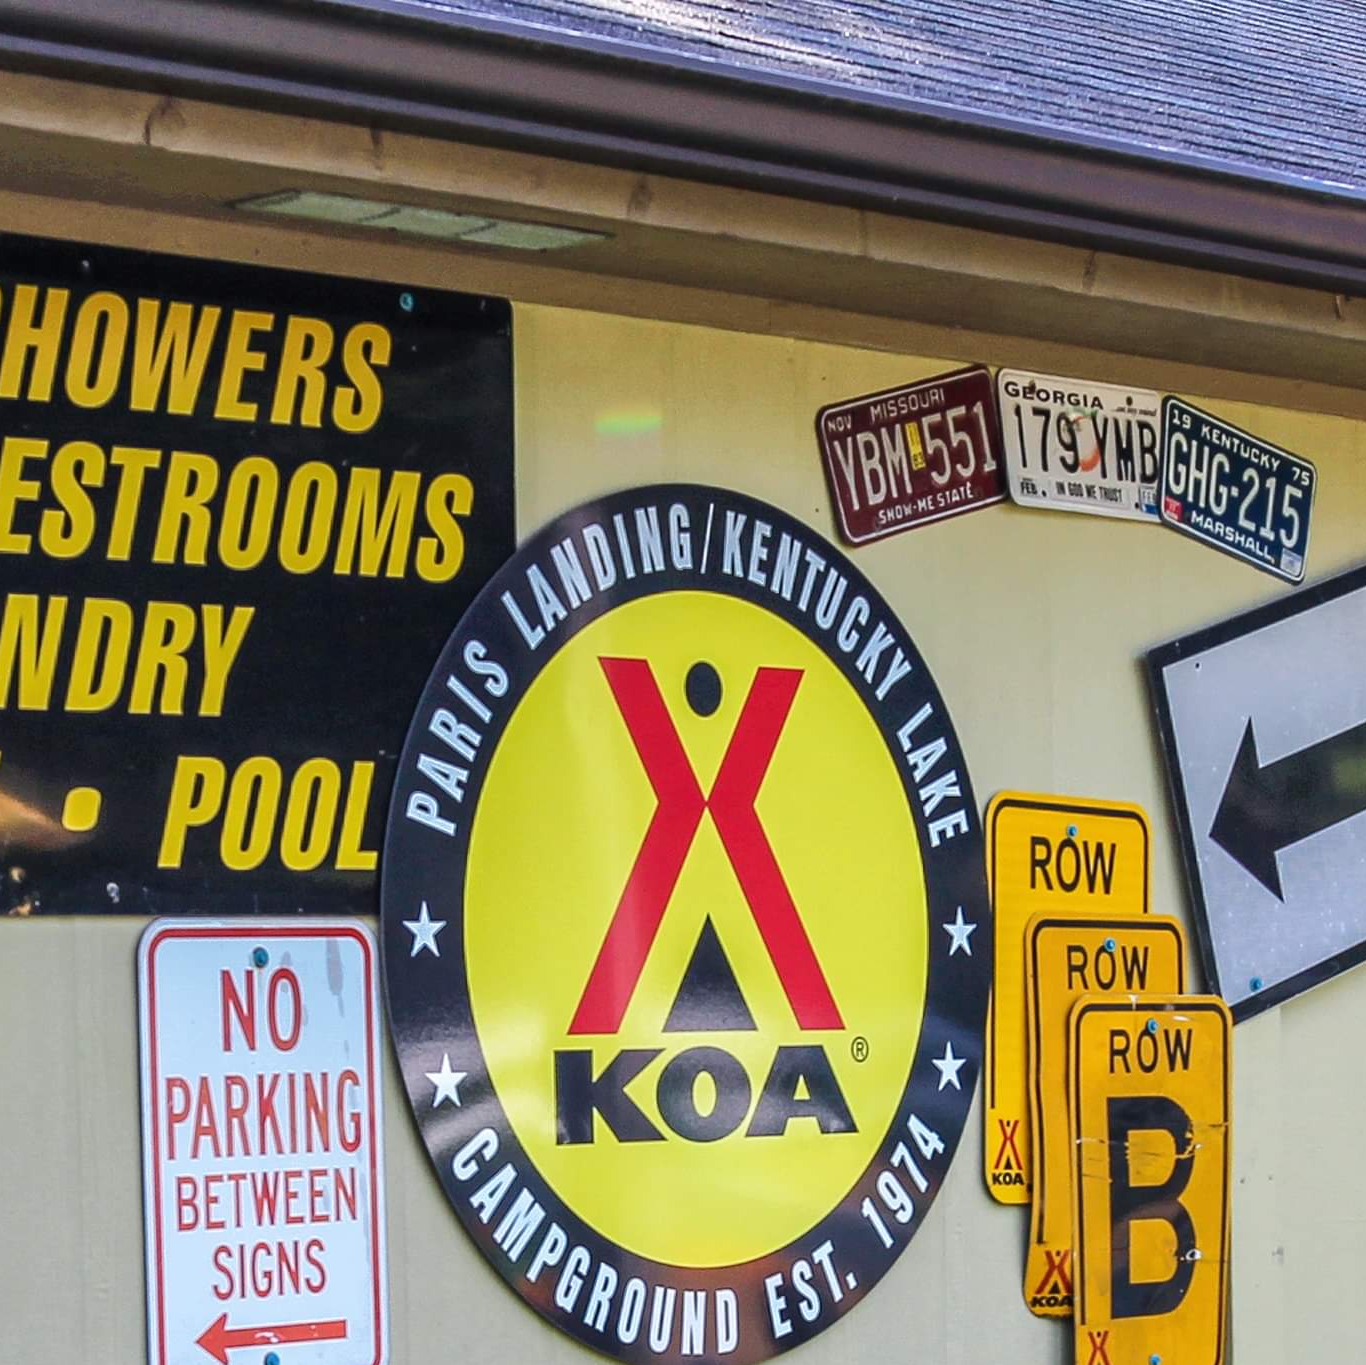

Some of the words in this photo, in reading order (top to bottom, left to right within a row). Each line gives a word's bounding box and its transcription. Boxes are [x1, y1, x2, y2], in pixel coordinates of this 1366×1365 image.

[828, 414, 852, 433] NOV
[870, 388, 945, 424] MISSOURI
[1004, 381, 1104, 410] GEORGIA
[1014, 403, 1080, 474] 179
[1091, 412, 1158, 484] YMB
[1172, 409, 1192, 430] 19
[1201, 424, 1281, 473] KENTUCKY
[1291, 467, 1310, 486] 75
[938, 482, 973, 507] STATE
[1191, 510, 1275, 564] MARSHALL
[406, 639, 511, 838] PARIS
[895, 702, 971, 848] LAKE
[157, 756, 379, 871] POOL
[1029, 835, 1117, 895] ROW
[1066, 944, 1149, 990] ROW
[220, 967, 303, 1052] NO
[1108, 1028, 1193, 1074] ROW
[166, 1068, 362, 1160] PARKING
[553, 1045, 859, 1146] KOA
[175, 1167, 358, 1233] BETWEEN
[992, 1173, 1024, 1186] KOA
[1106, 1095, 1197, 1320] B
[451, 1127, 739, 1356] CAMPGROUND
[764, 1239, 858, 1339] EST.
[860, 1113, 946, 1249] 1974
[212, 1239, 327, 1301] SIGNS
[1031, 1296, 1074, 1308] KOA
